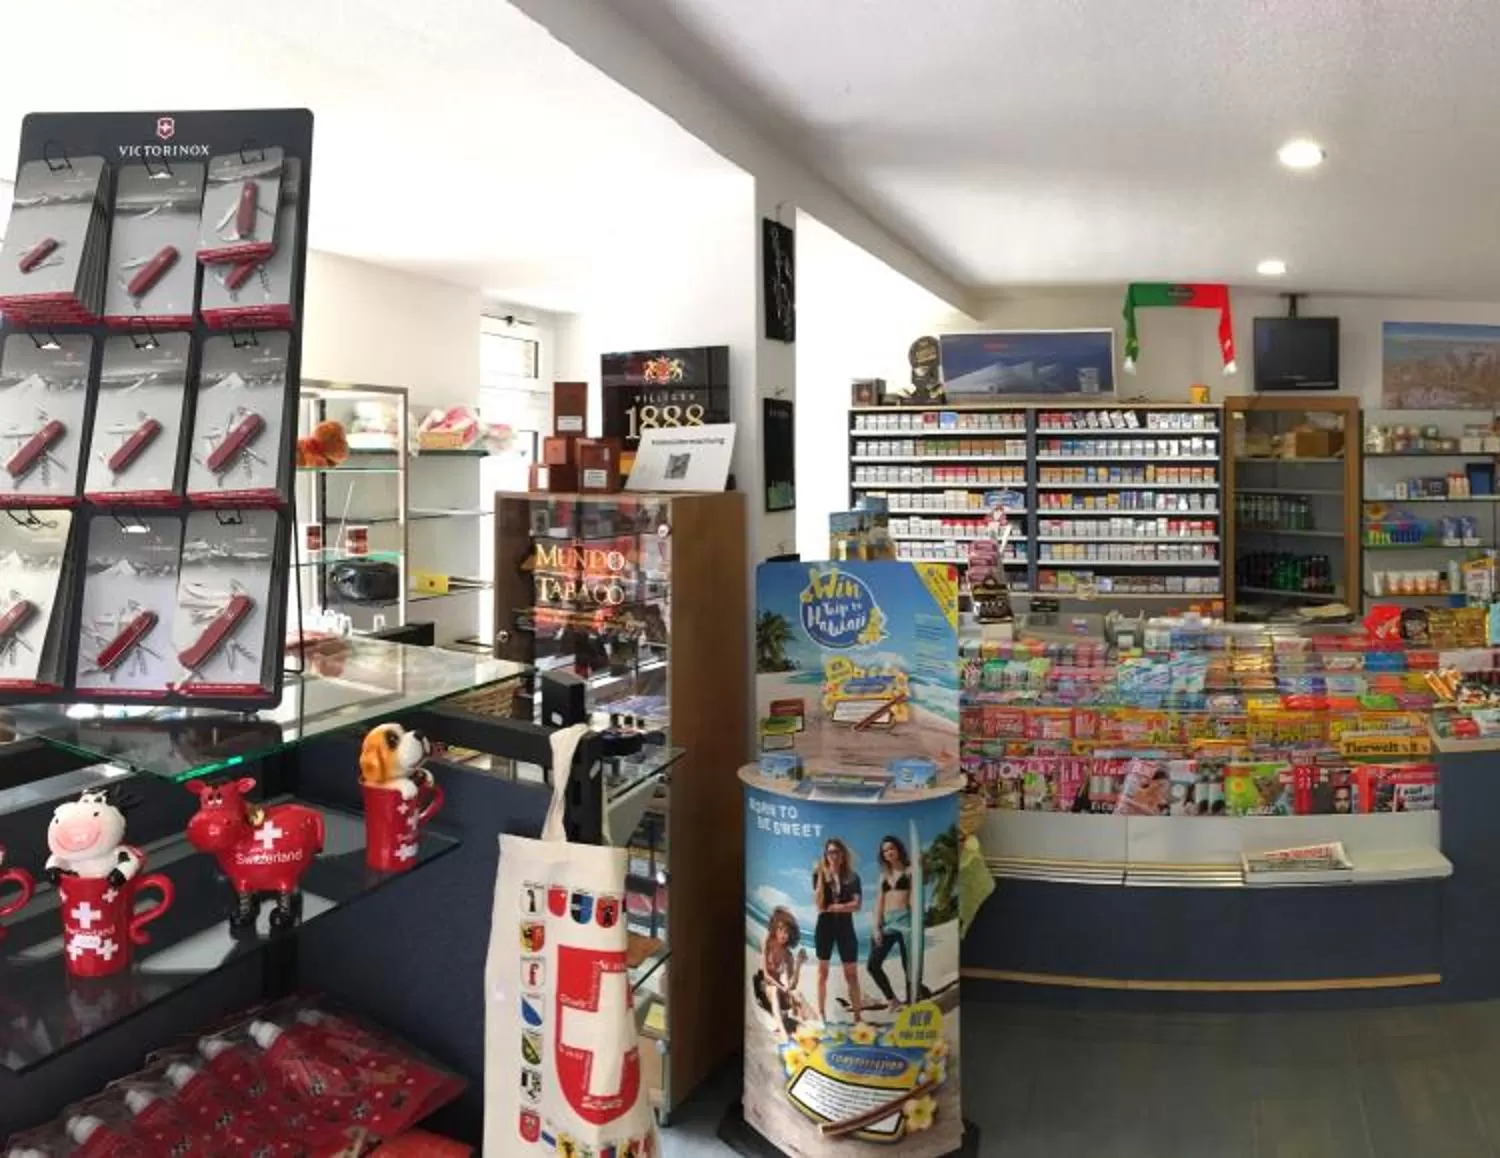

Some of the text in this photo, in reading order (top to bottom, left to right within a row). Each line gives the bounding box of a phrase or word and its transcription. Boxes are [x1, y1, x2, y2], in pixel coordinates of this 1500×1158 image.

[118, 144, 210, 157] VICTORINOX
[625, 403, 705, 439] 1888
[535, 543, 625, 572] MUNDO
[534, 577, 625, 605] TABACO
[808, 567, 862, 599] Win
[807, 605, 866, 637] Hawaii
[779, 804, 799, 819] TO
[773, 821, 824, 838] SWEET
